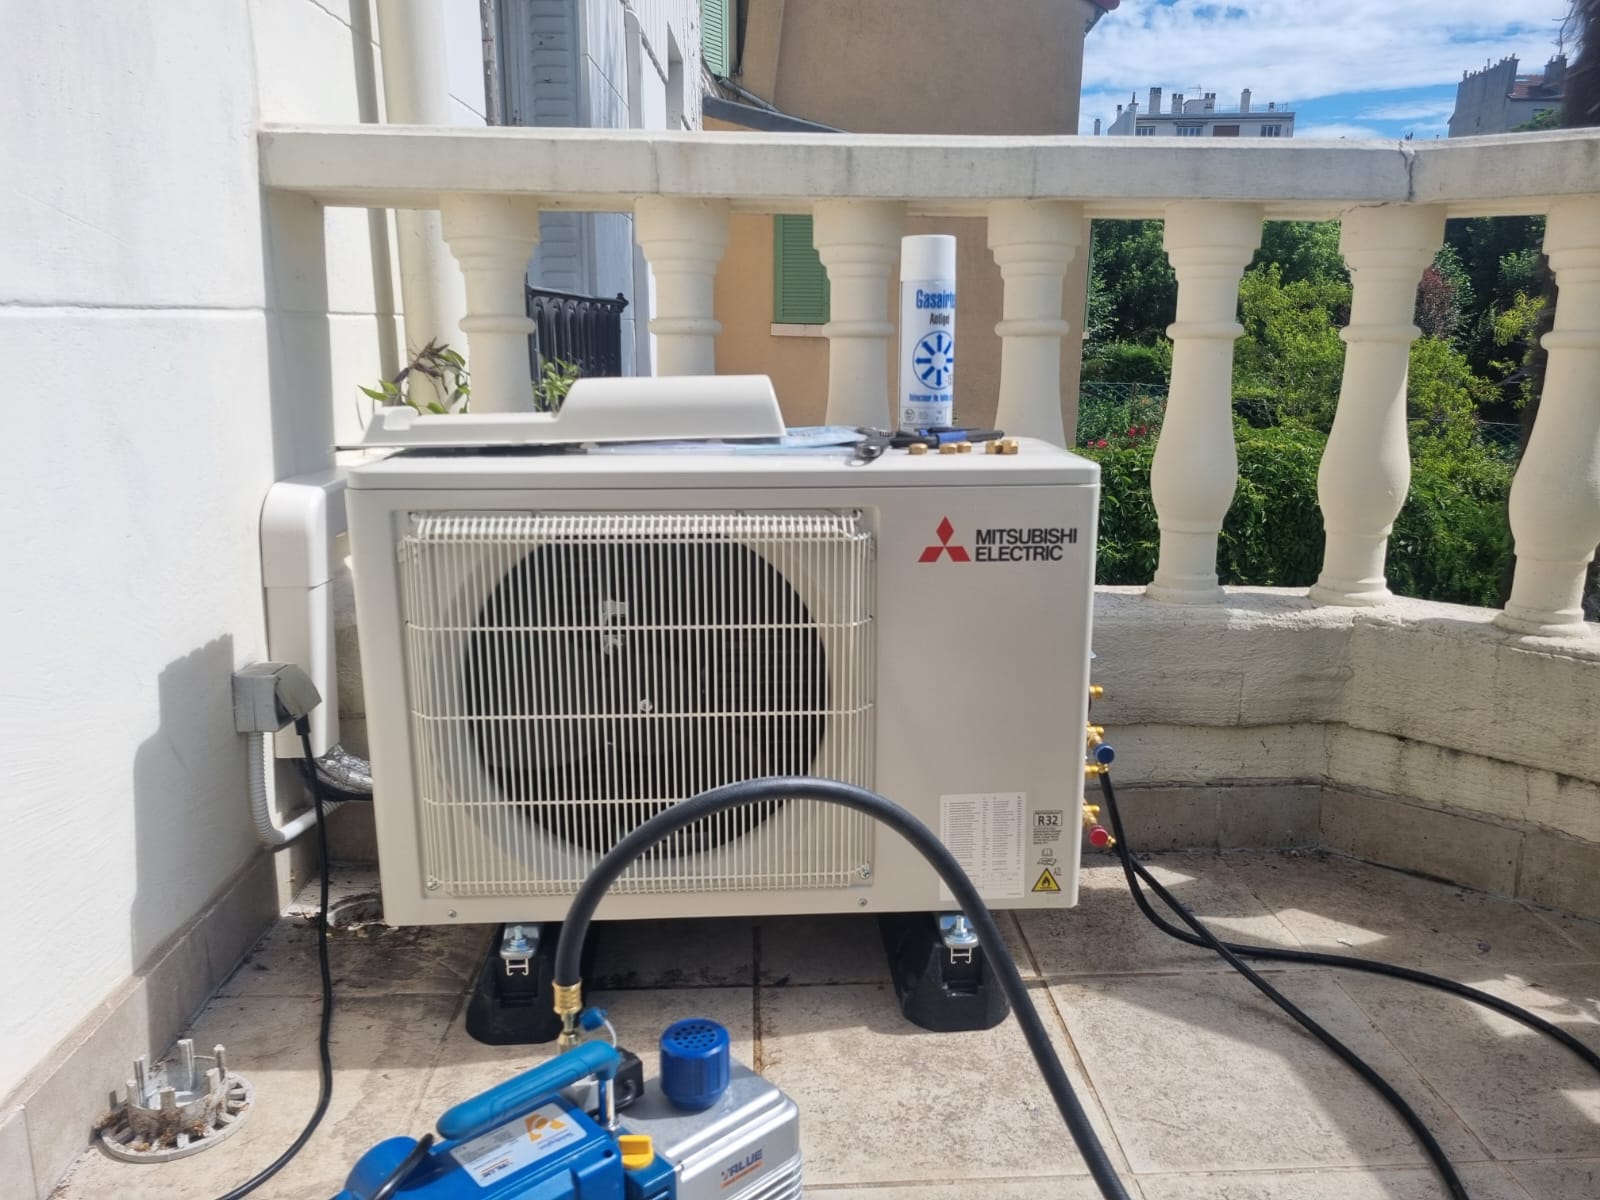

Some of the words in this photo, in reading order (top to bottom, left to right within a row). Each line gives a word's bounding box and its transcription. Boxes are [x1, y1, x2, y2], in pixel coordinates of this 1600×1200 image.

[975, 528, 1077, 545] MITSUBISHI
[975, 545, 1063, 562] ELECTRIC
[1038, 815, 1058, 826] R32
